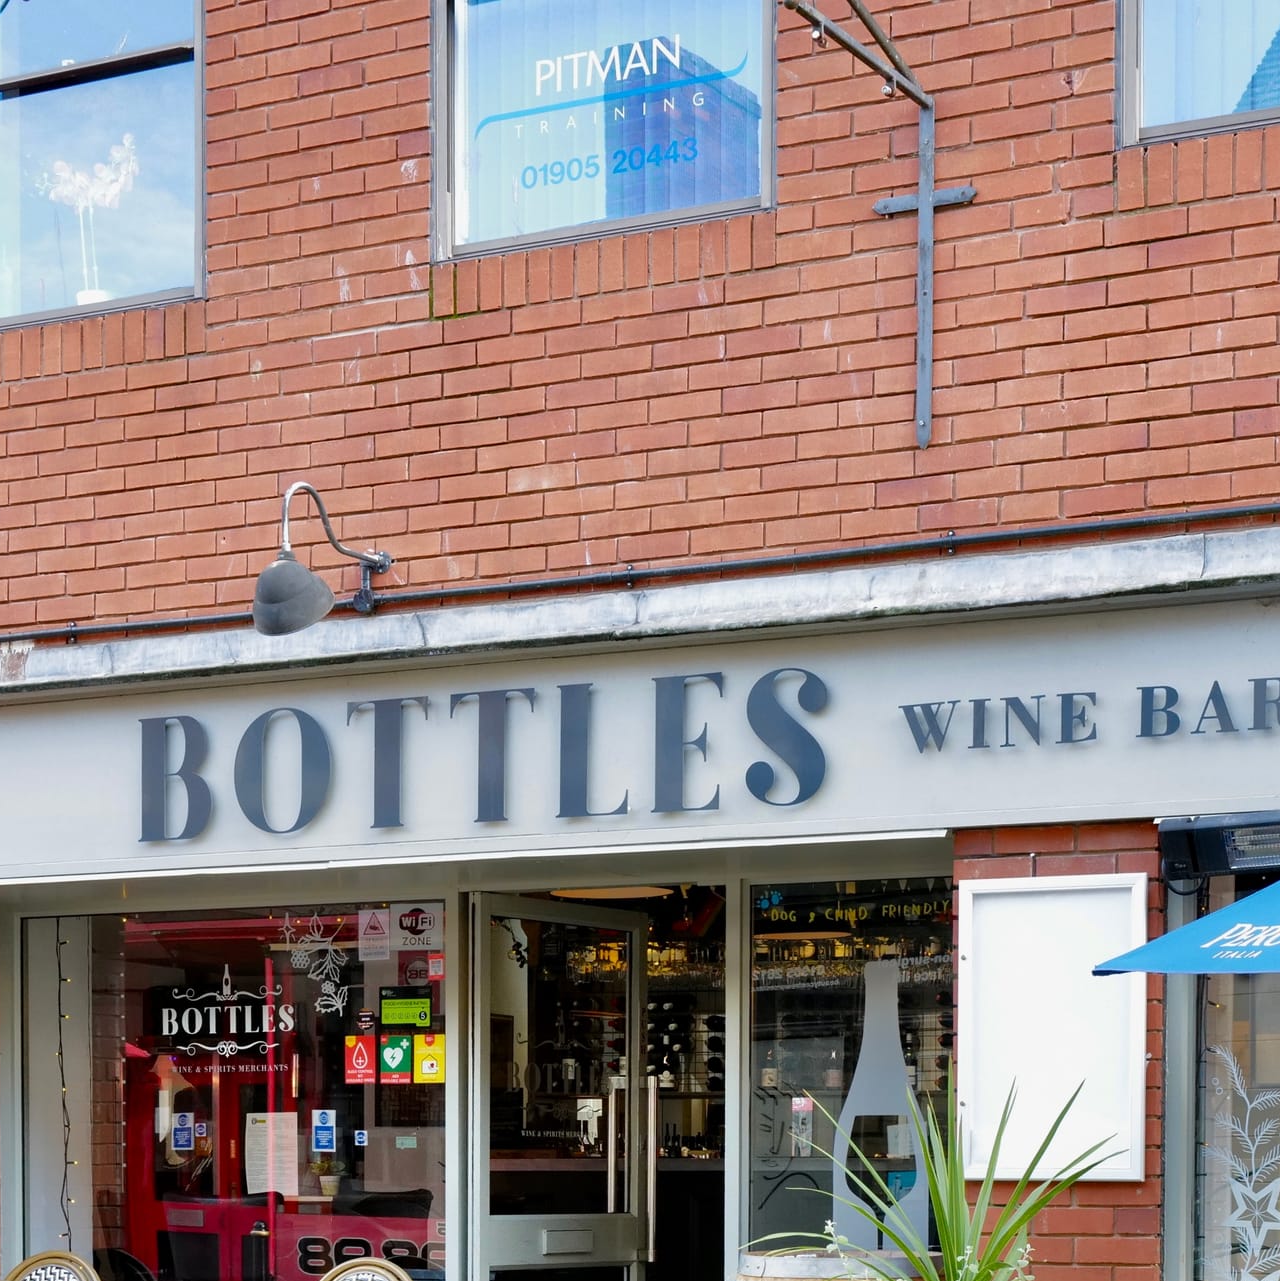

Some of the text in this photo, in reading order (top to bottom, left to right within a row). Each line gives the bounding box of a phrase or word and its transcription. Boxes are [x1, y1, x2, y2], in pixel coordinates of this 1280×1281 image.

[535, 34, 680, 96] PITMAN
[515, 91, 704, 138] TRAINING
[521, 136, 698, 189] 01905 20443
[138, 667, 828, 843] BOTTLES
[899, 691, 1097, 754] WINE
[771, 909, 797, 922] DOG
[882, 900, 951, 918] FRIENDLY
[402, 937, 432, 946] ZONE
[1212, 951, 1264, 960] ITALIA
[162, 1004, 295, 1036] BOTTLES
[238, 1064, 289, 1073] MERCHANTS
